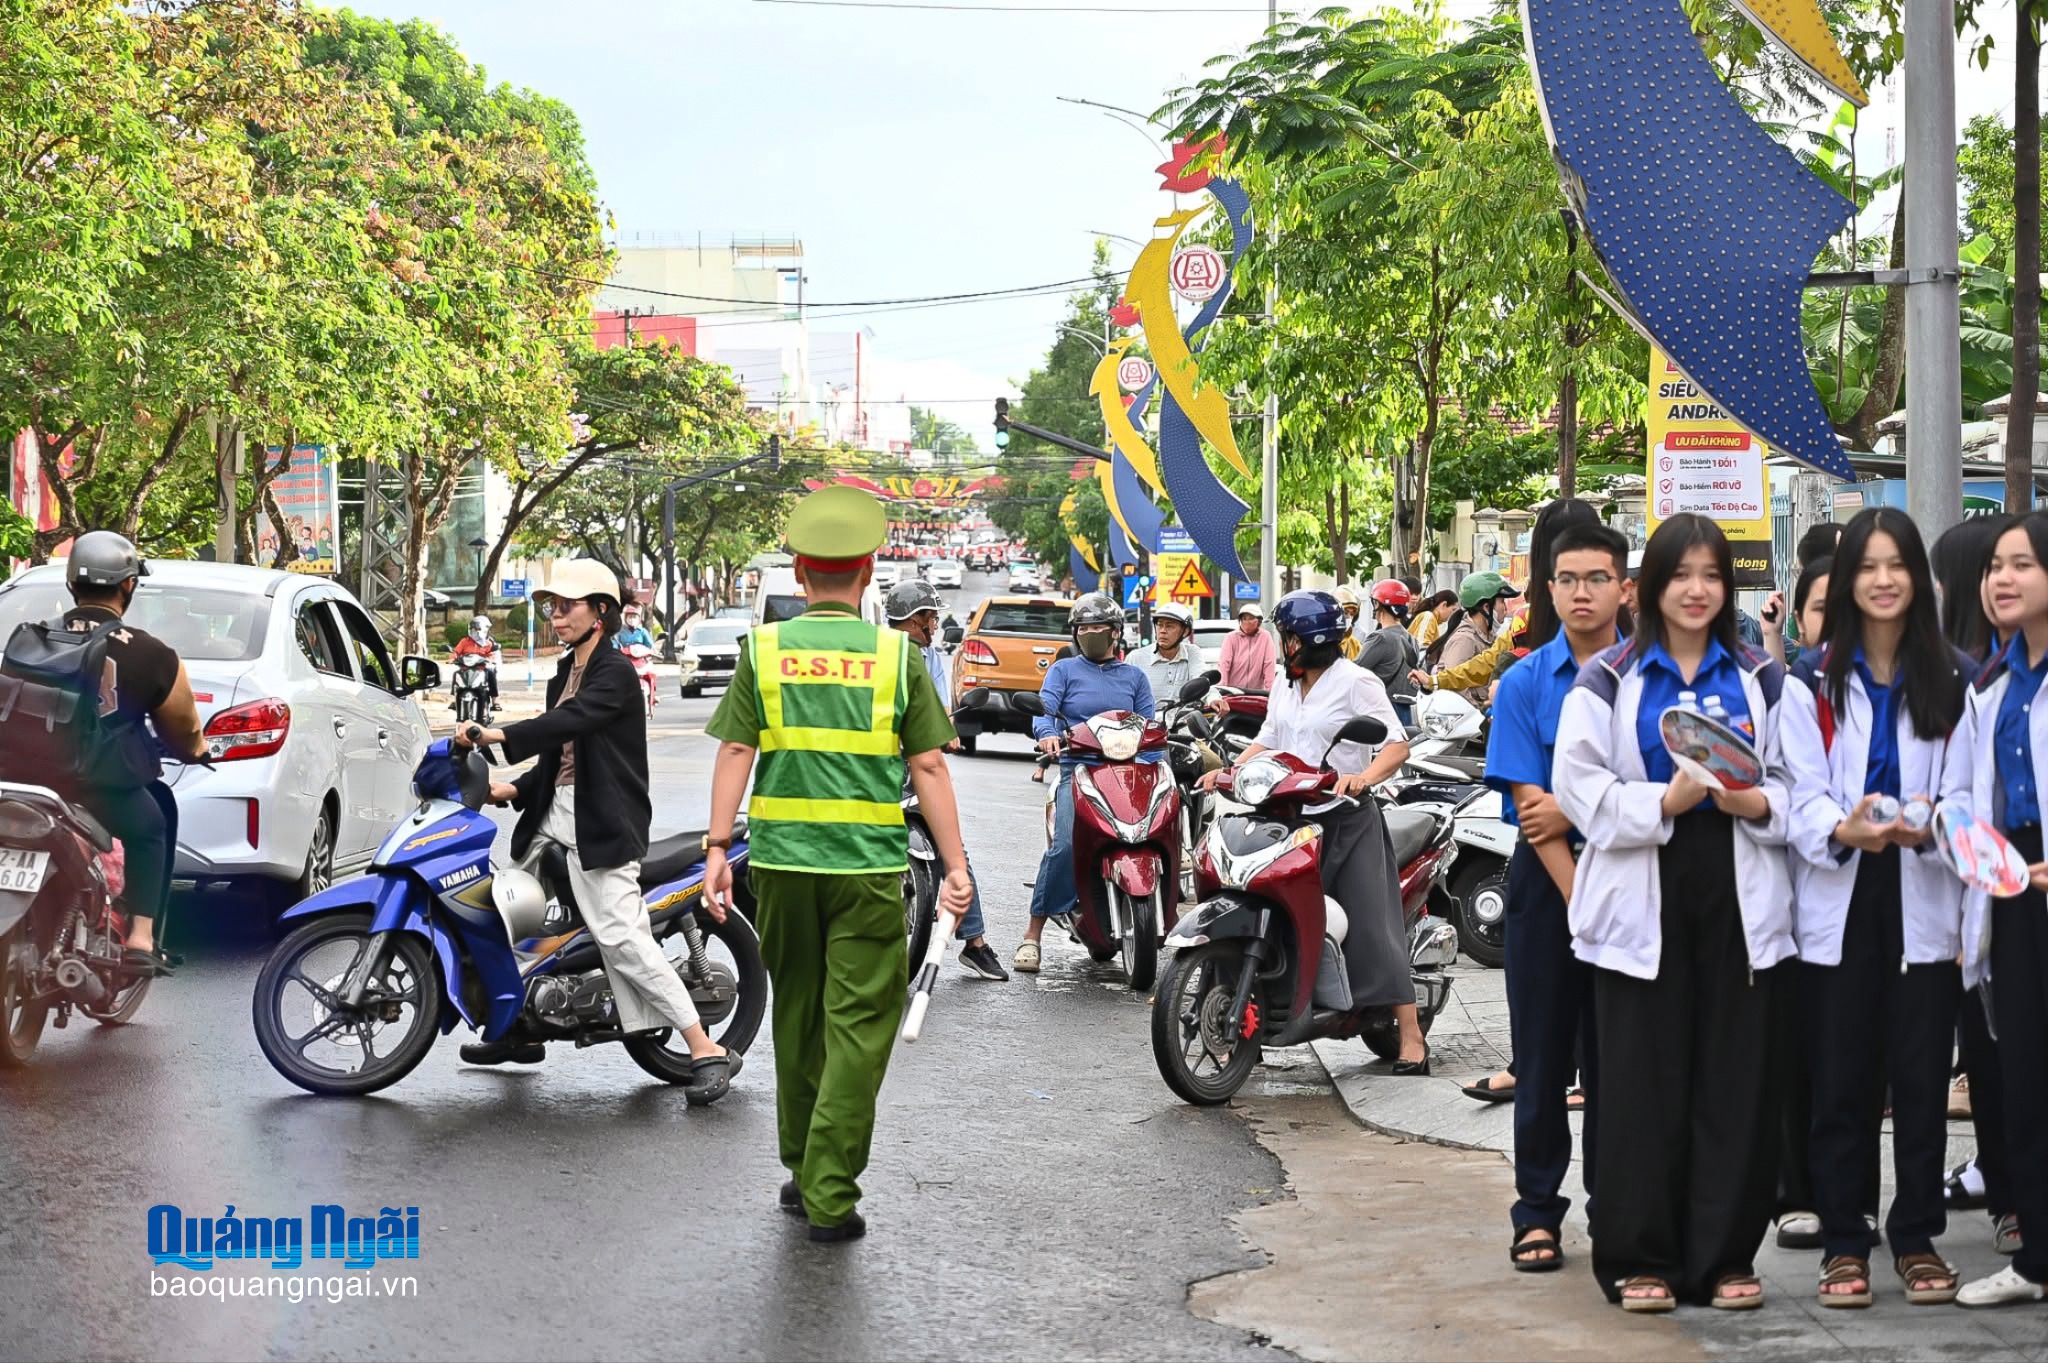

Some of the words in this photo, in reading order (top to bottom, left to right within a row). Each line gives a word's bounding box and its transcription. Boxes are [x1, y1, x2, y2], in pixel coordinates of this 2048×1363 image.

[1659, 379, 1699, 398] SIÊU
[1741, 502, 1758, 511] Cao
[781, 657, 877, 680] C.S.T.T
[438, 864, 481, 889] YAMAHA
